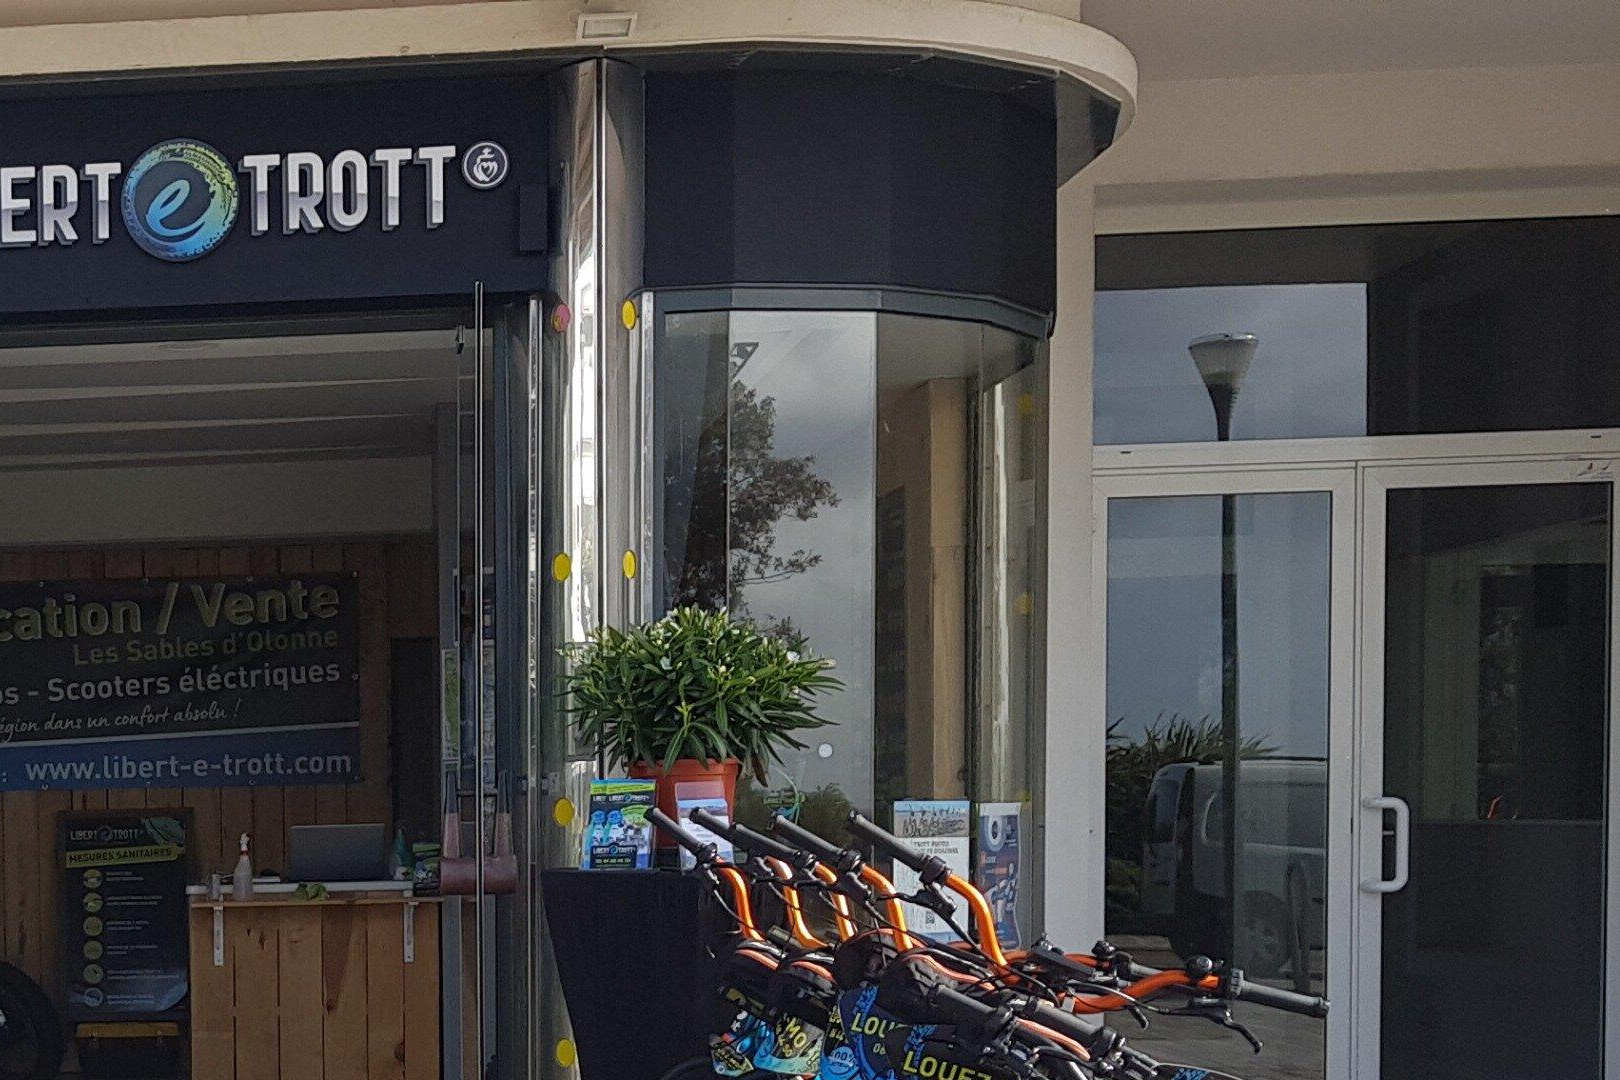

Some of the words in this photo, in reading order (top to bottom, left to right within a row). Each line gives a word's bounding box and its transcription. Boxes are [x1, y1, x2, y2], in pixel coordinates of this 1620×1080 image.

[238, 145, 457, 237] TROTT
[191, 579, 341, 628] Vente
[73, 643, 118, 667] Les
[126, 630, 214, 662] Sables
[47, 672, 171, 702] Scooters
[45, 711, 83, 730] dans
[87, 712, 111, 729] un
[113, 704, 169, 735] confort
[174, 698, 227, 722] absolu
[25, 750, 353, 782] www.libert-e-trott.com
[68, 851, 115, 863] MESURES
[116, 848, 173, 860] SANITAIRES
